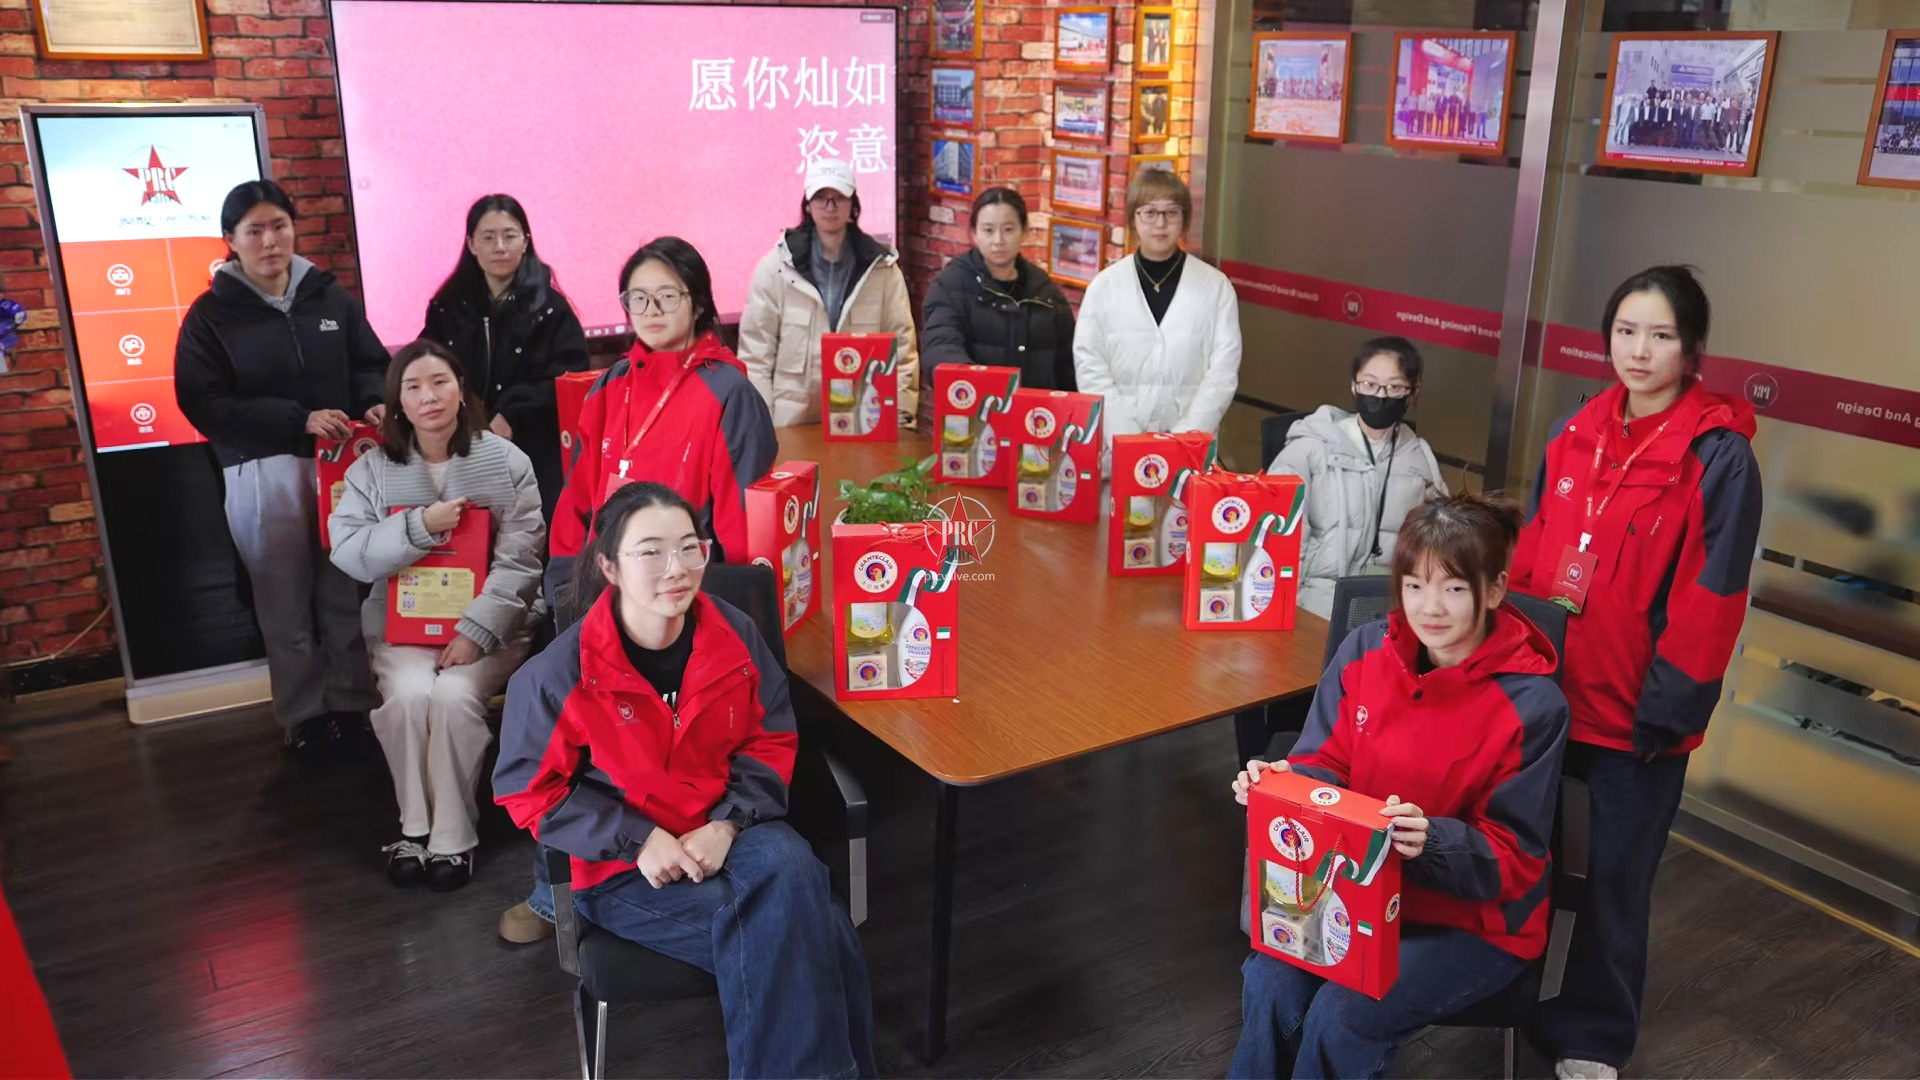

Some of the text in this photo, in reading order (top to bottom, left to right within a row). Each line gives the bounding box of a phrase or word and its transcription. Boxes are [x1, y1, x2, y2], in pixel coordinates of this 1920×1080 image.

[688, 55, 888, 112] 愿你灿如
[796, 123, 889, 175] 恣意
